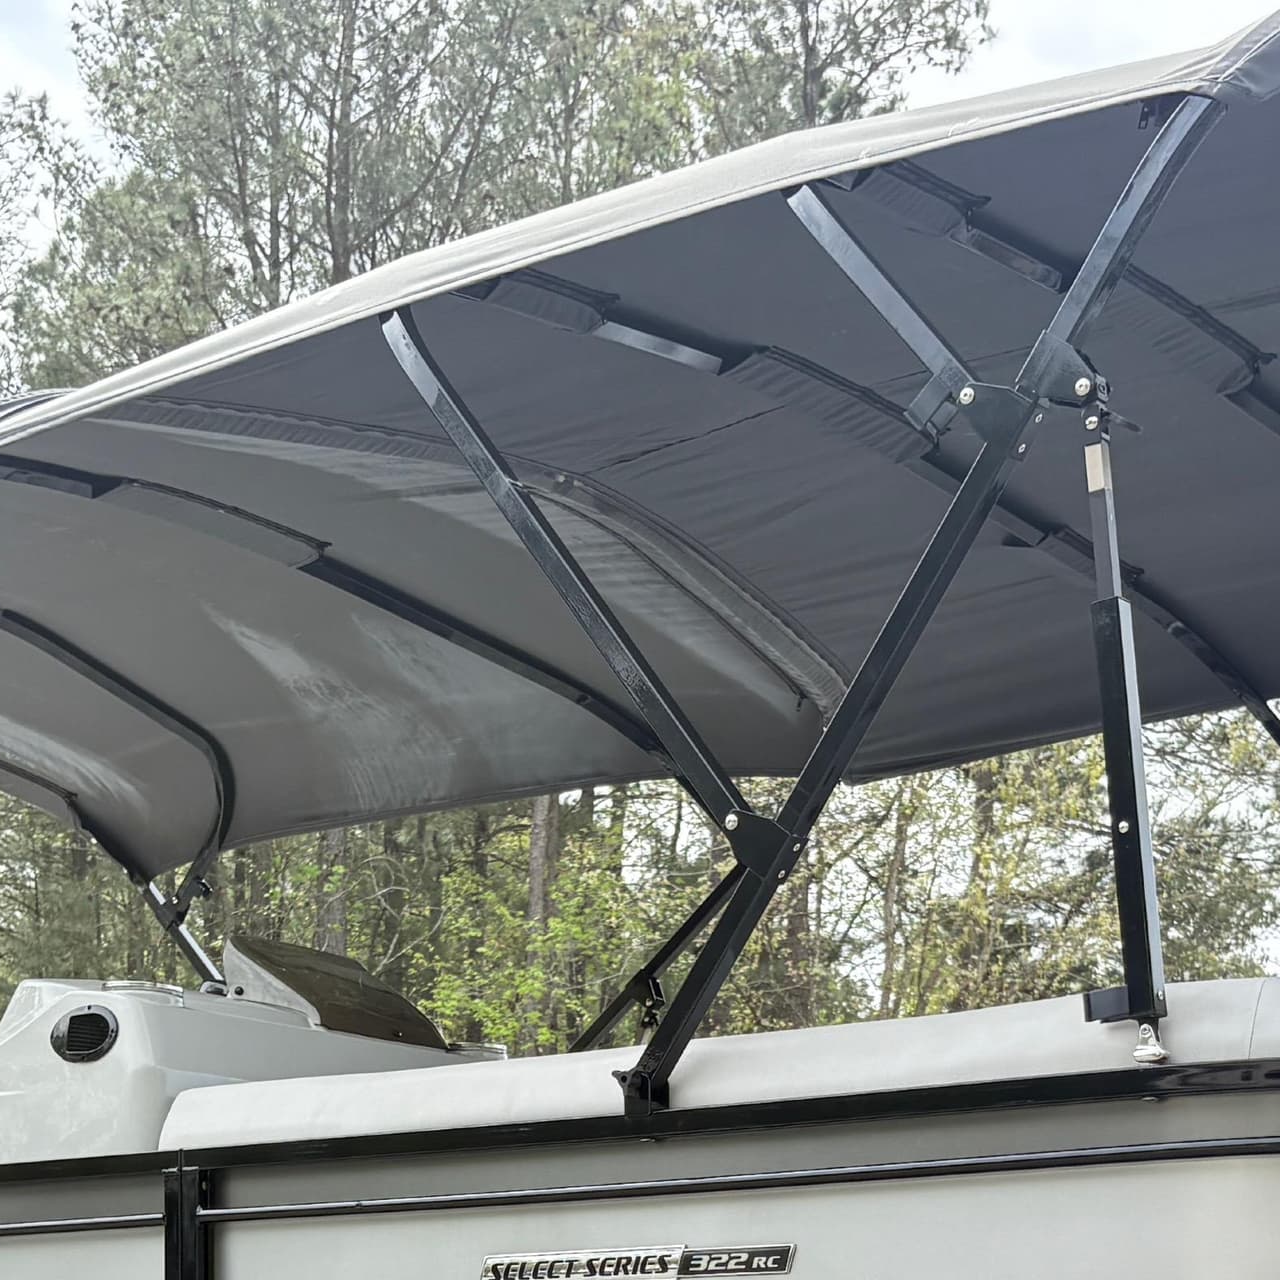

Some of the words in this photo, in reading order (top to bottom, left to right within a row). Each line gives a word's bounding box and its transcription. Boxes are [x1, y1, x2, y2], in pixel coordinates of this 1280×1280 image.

[583, 1254, 673, 1278] SERIES
[688, 1252, 750, 1272] 322
[751, 1255, 782, 1269] RC
